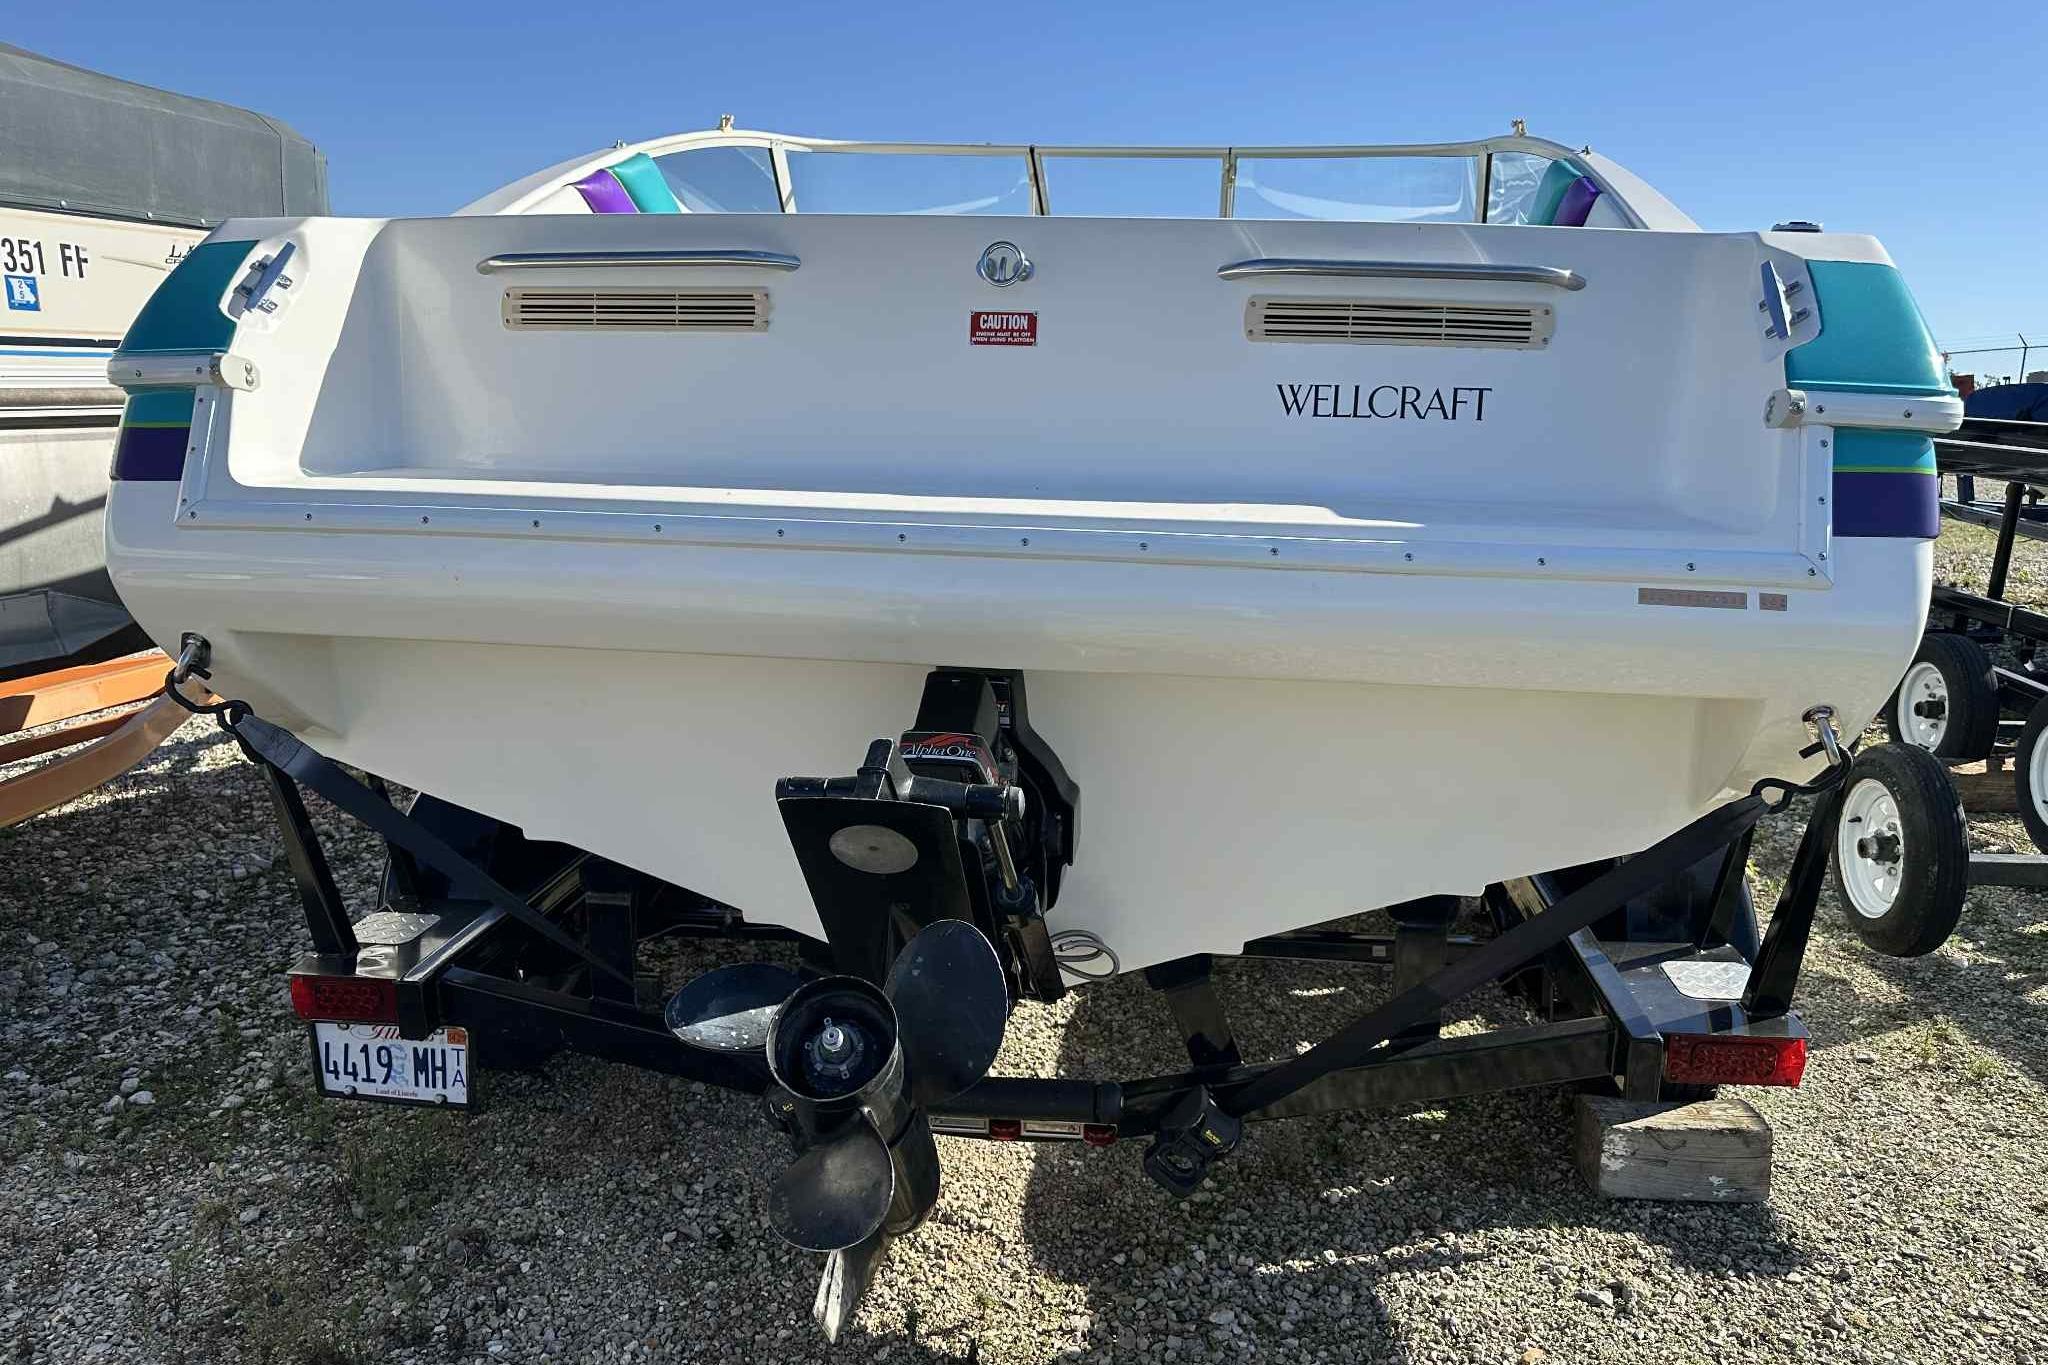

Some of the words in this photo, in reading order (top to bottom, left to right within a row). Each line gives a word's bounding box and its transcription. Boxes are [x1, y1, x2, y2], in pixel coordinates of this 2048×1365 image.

[1, 238, 46, 275] 351
[980, 314, 1029, 330] CAUTION
[1276, 383, 1493, 421] WELLCRAFT
[903, 742, 946, 757] Alpha
[946, 745, 976, 758] One
[323, 1041, 393, 1085] 4419
[412, 1046, 447, 1090] MH
